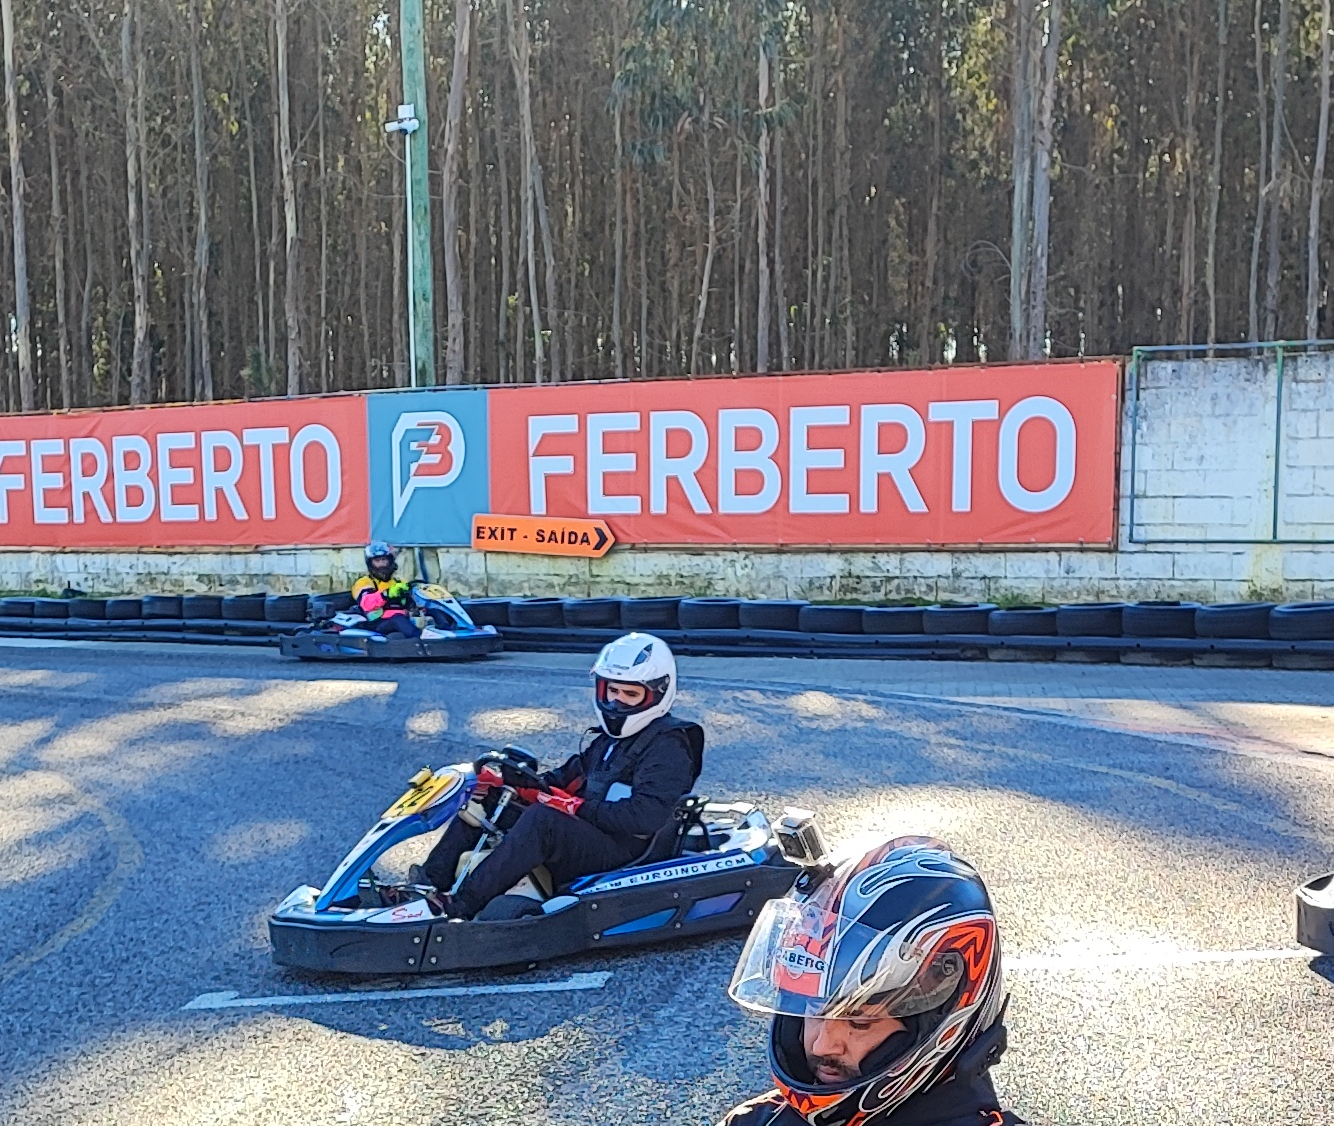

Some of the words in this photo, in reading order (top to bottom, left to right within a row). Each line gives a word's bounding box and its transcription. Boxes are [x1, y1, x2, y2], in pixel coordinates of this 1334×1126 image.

[528, 395, 1077, 515] FERBERTO
[476, 525, 517, 541] EXIT
[535, 527, 591, 546] SAÍDA
